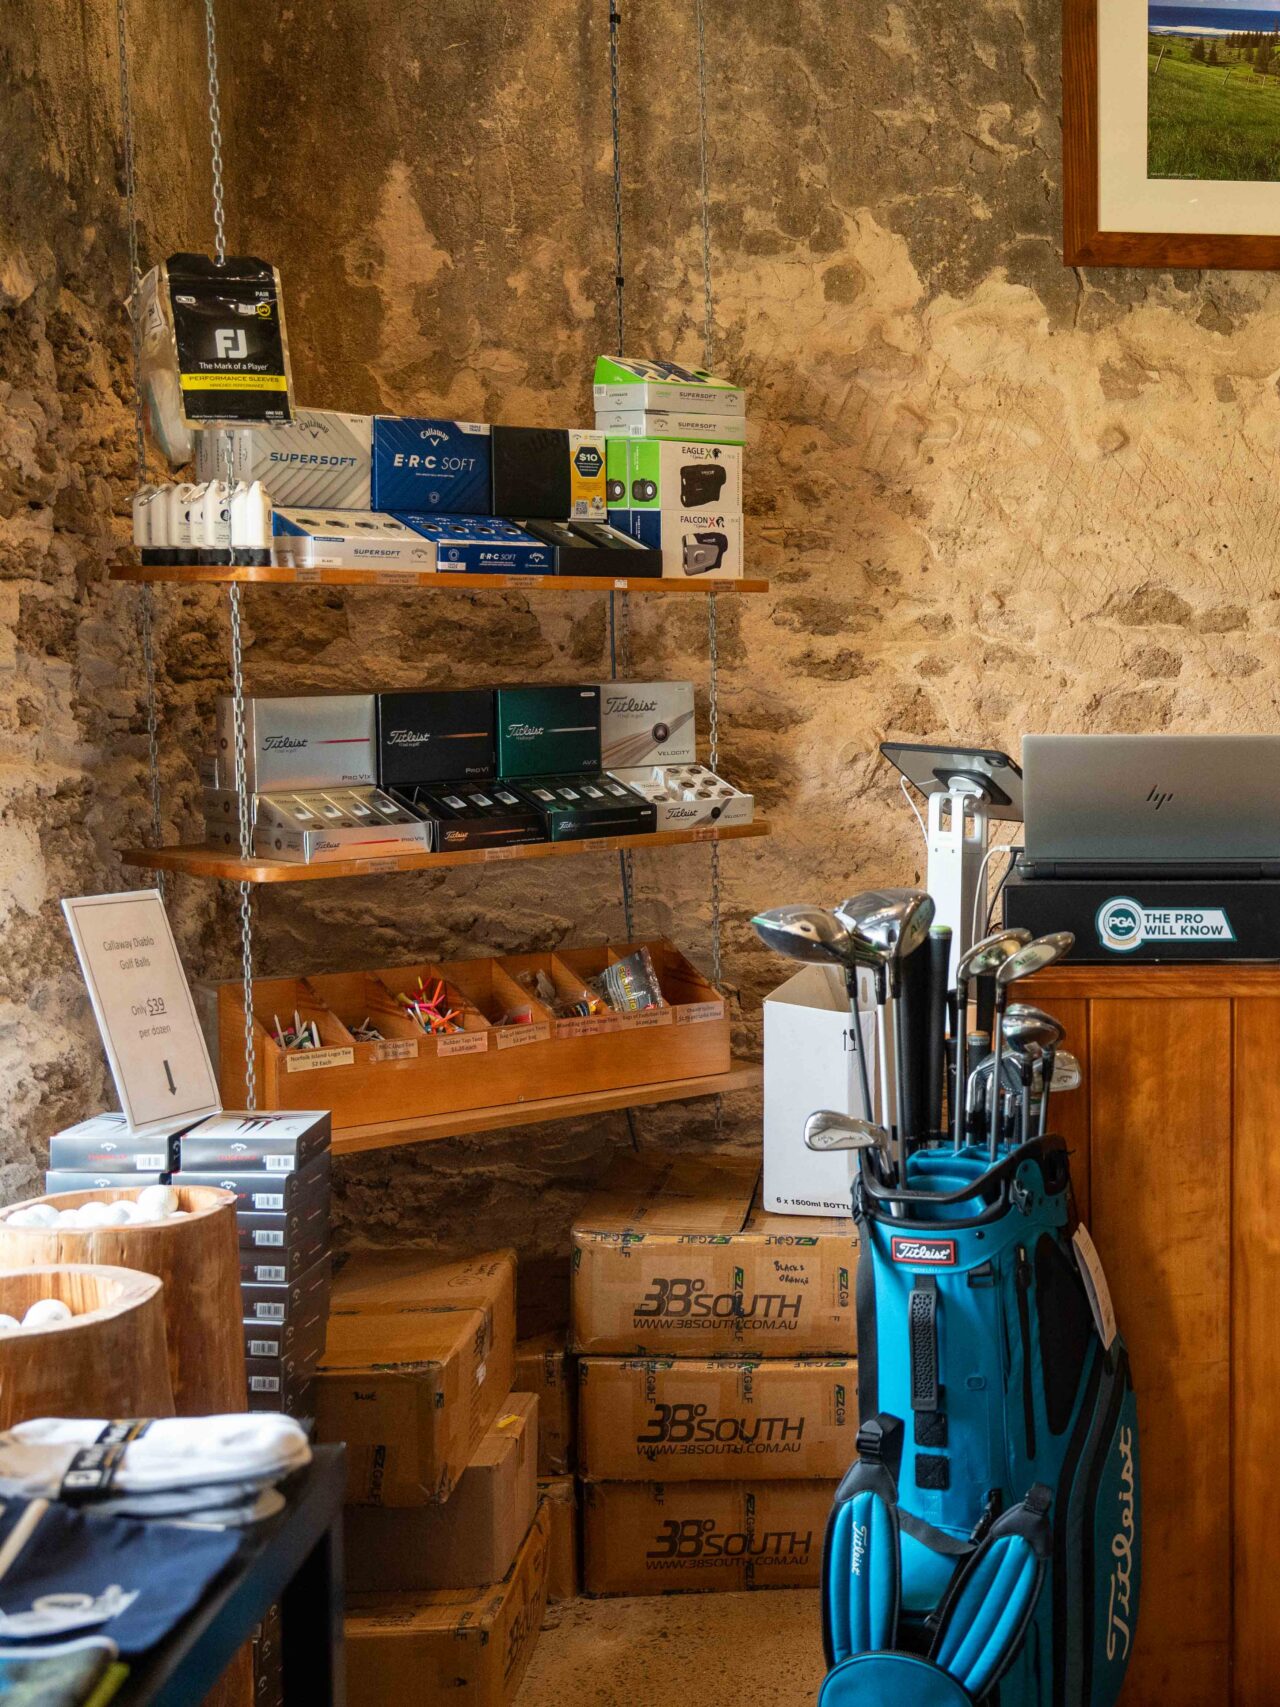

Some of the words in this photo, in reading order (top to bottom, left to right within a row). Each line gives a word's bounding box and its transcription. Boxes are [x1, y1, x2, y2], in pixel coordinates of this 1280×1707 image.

[214, 328, 249, 359] FJ
[199, 362, 214, 370] The
[214, 362, 233, 370] Mark
[233, 362, 242, 370] of
[247, 363, 268, 371] Player
[679, 391, 717, 399] SUPERSOFT
[299, 419, 330, 435] Callaway
[420, 427, 450, 442] Callaway
[579, 452, 598, 462] $10
[681, 446, 705, 456] EAGLE
[270, 451, 357, 467] SUPERSOFT
[441, 456, 476, 472] SOFT
[680, 515, 708, 525] FALCON
[354, 549, 401, 557] SUPERSOFT
[500, 552, 517, 562] SOFT
[603, 695, 658, 715] Titleist
[387, 730, 430, 745] Titleist
[505, 723, 545, 738] Titleist
[262, 736, 309, 751] Titleist
[1146, 783, 1174, 810] hp
[665, 807, 699, 819] Titleist
[445, 831, 469, 840] Titleist
[315, 841, 341, 850] Titleist
[1108, 916, 1136, 928] PGA
[1144, 913, 1171, 924] THE
[1175, 913, 1204, 924] PRO
[1144, 925, 1177, 935] WILL
[1180, 925, 1224, 936] KNOW
[102, 940, 133, 952] Callaway
[132, 936, 155, 947] Diablo
[119, 958, 134, 970] Golf
[135, 956, 151, 969] Balls
[131, 1004, 148, 1016] Only
[147, 997, 167, 1016] $39
[139, 1028, 151, 1039] per
[151, 1023, 172, 1036] dozen
[290, 1054, 310, 1062] Norfolk
[310, 1051, 327, 1059] Island
[327, 1050, 340, 1059] Logo
[776, 1196, 782, 1204] 6
[791, 1197, 822, 1208] 1500ml
[823, 1200, 851, 1210] BOTTL
[896, 1242, 950, 1260] Titleist
[774, 1261, 799, 1272] BLACK
[633, 1318, 799, 1331] WWW.38SOUTH.COM.AU
[636, 1443, 801, 1456] WWW.38SOUTH.COM.AU
[851, 1521, 868, 1577] Titleist
[1106, 1425, 1135, 1661] Titleist
[646, 1555, 810, 1570] WWW.38SOUTH.COM.AU
